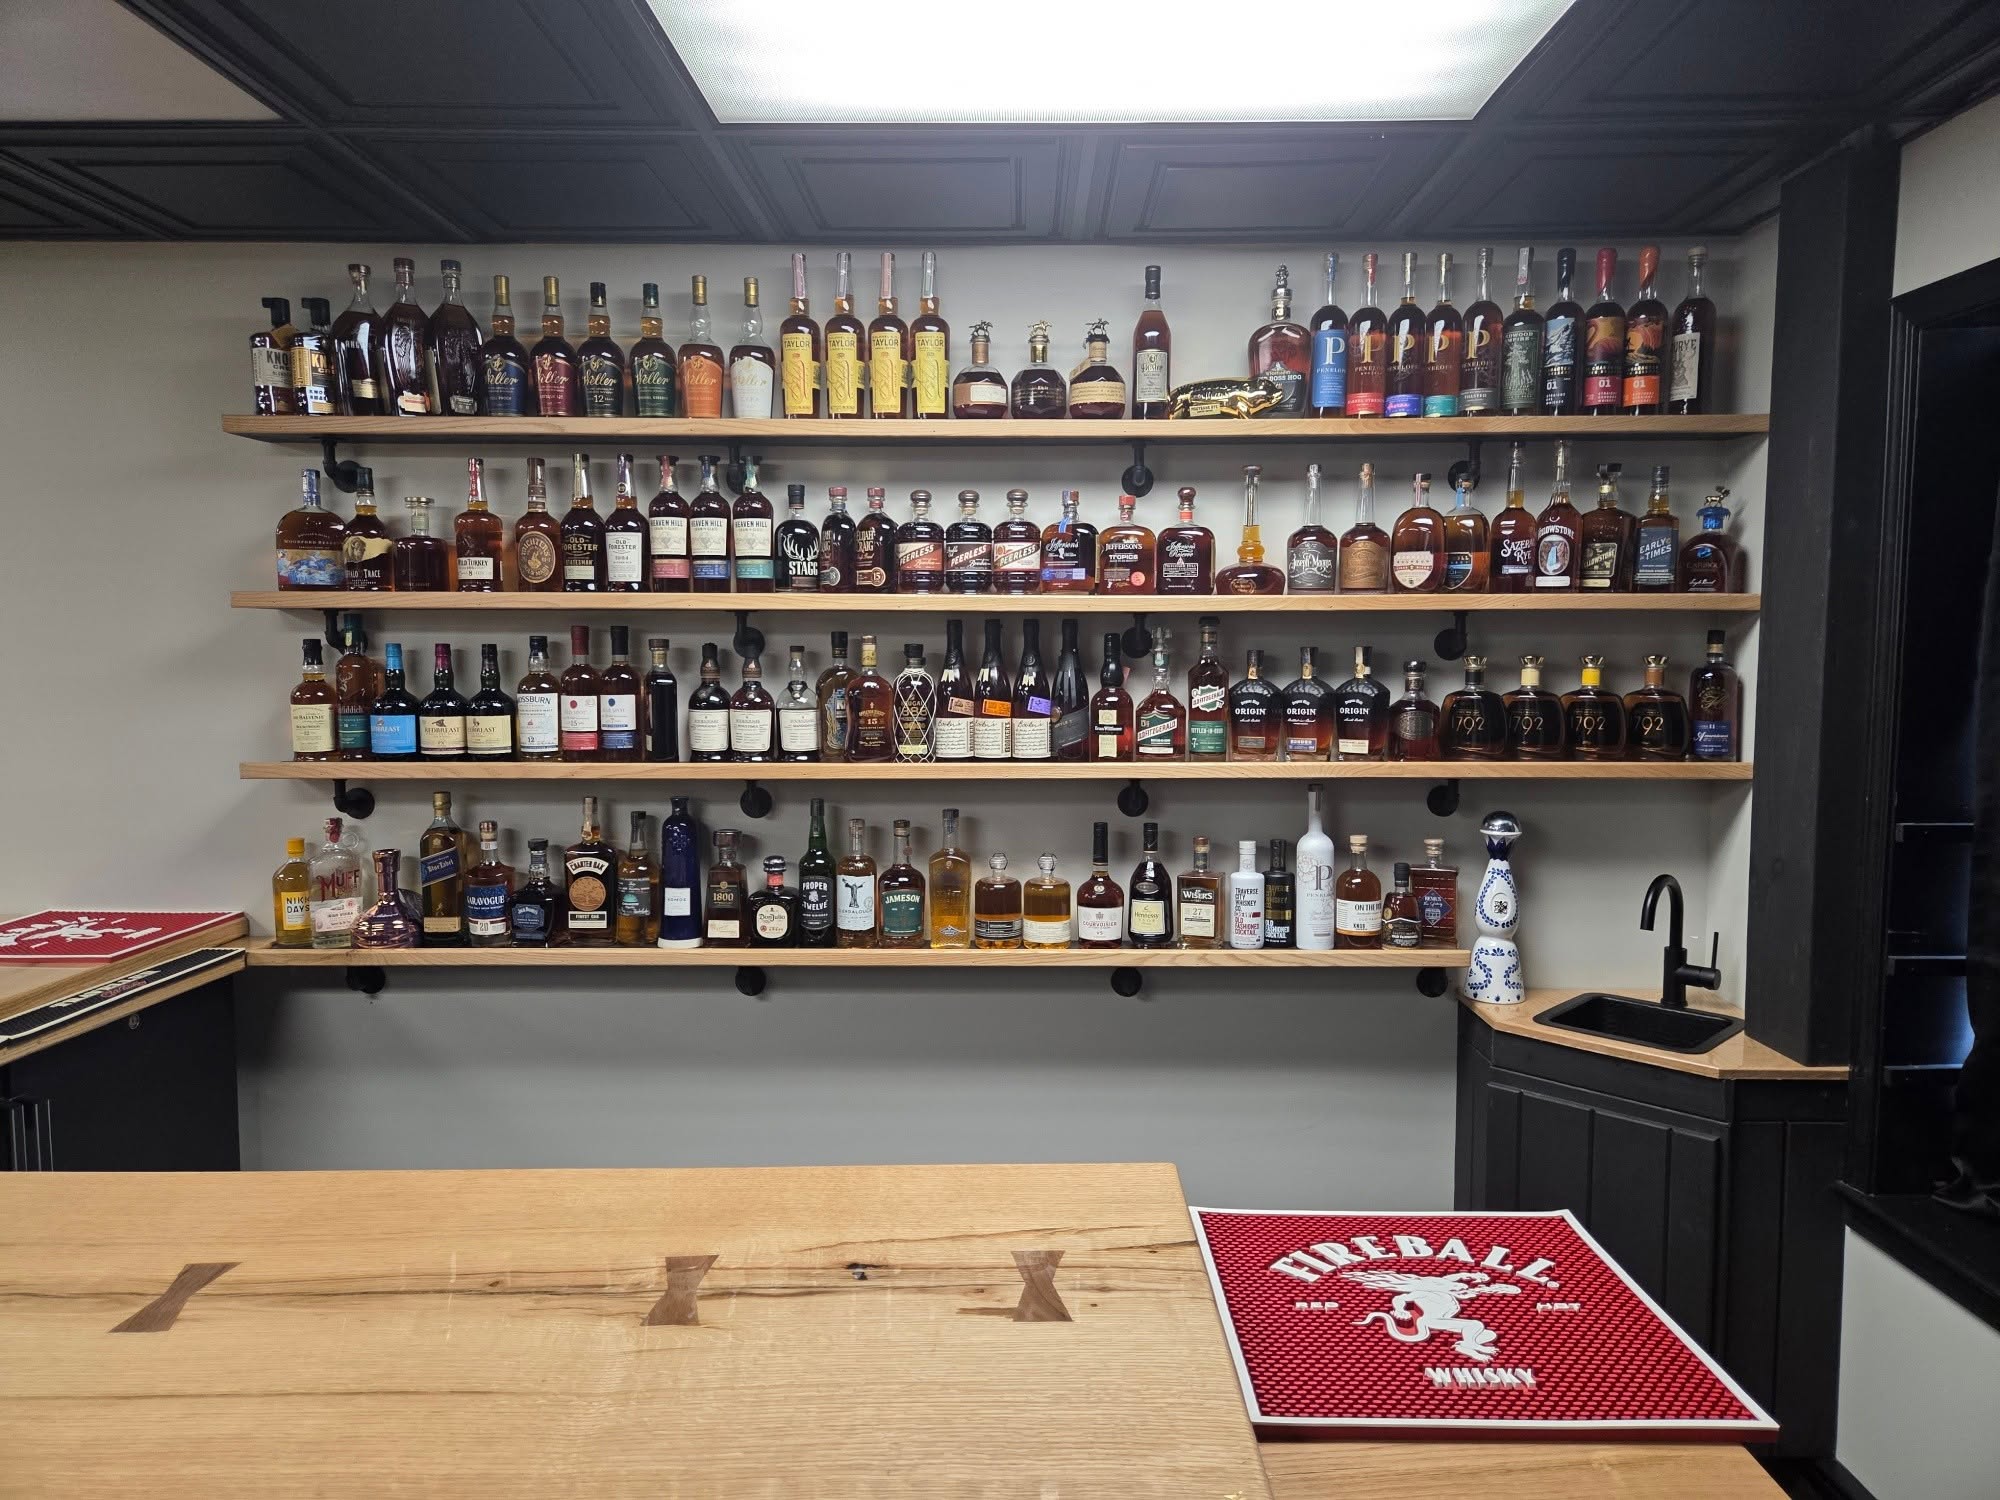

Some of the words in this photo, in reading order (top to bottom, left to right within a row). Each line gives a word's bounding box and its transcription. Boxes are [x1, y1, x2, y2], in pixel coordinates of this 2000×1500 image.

[784, 340, 810, 348] TAYLOR
[829, 339, 855, 347] TAYLOR
[872, 338, 898, 346] TAYLOR
[1467, 330, 1491, 359] P
[1322, 336, 1346, 364] P
[1362, 334, 1386, 364] P
[1391, 333, 1415, 364] P
[1428, 335, 1450, 364] P
[266, 350, 289, 364] KNO
[1598, 379, 1610, 388] 01
[1632, 378, 1646, 388] 01
[594, 394, 604, 402] 12
[712, 520, 722, 528] HILL
[1106, 543, 1142, 551] JEFFERSON'S
[1640, 538, 1667, 554] EARLY
[900, 544, 934, 567] PEERLESS
[951, 545, 987, 568] PEERLESS
[1000, 544, 1036, 567] PEERLESS
[1645, 544, 1672, 561] TIMES
[364, 569, 381, 578] TRACE
[788, 562, 818, 576] STAGG
[518, 695, 552, 705] OSSBURN
[338, 704, 363, 714] fiddich
[1234, 708, 1266, 716] ORIGIN
[1286, 708, 1316, 716] ORIGIN
[1146, 718, 1178, 738] FITZGERALD
[593, 861, 604, 871] OAK
[1314, 864, 1332, 890] P
[316, 870, 360, 902] MUFF
[802, 882, 828, 891] PROPER
[286, 896, 310, 904] NIKK
[713, 892, 734, 900] 1800
[885, 894, 920, 904] JAMESON
[1182, 890, 1212, 900] WISER'S
[286, 904, 310, 914] DAYS
[802, 901, 828, 911] TWELVE
[1134, 912, 1158, 920] Hennessy
[1192, 908, 1203, 916] 27
[1269, 1234, 1556, 1285] FIREBALL
[1424, 1367, 1537, 1391] WHISKY
